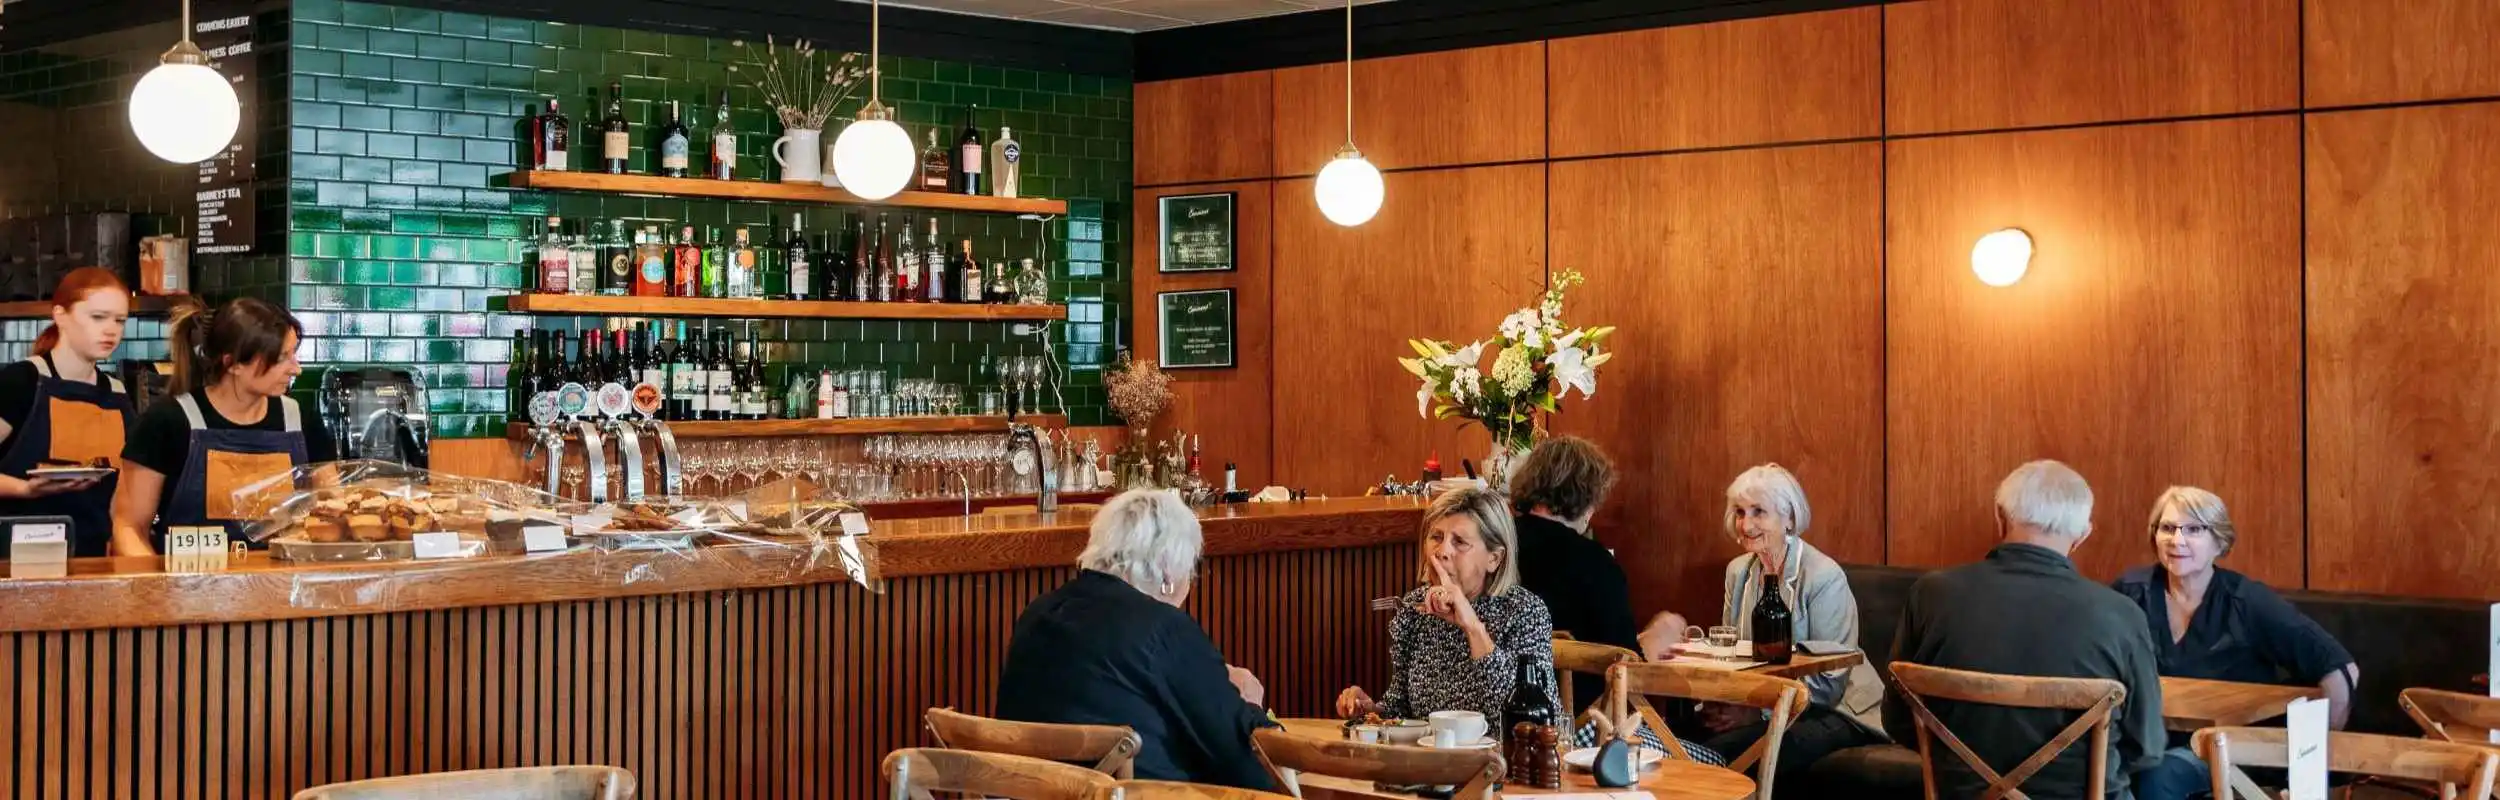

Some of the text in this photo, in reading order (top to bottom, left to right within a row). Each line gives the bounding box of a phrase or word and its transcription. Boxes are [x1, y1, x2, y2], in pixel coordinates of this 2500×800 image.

[228, 41, 252, 57] COFFEE
[227, 187, 241, 199] TEA
[176, 534, 221, 547] 19 13
